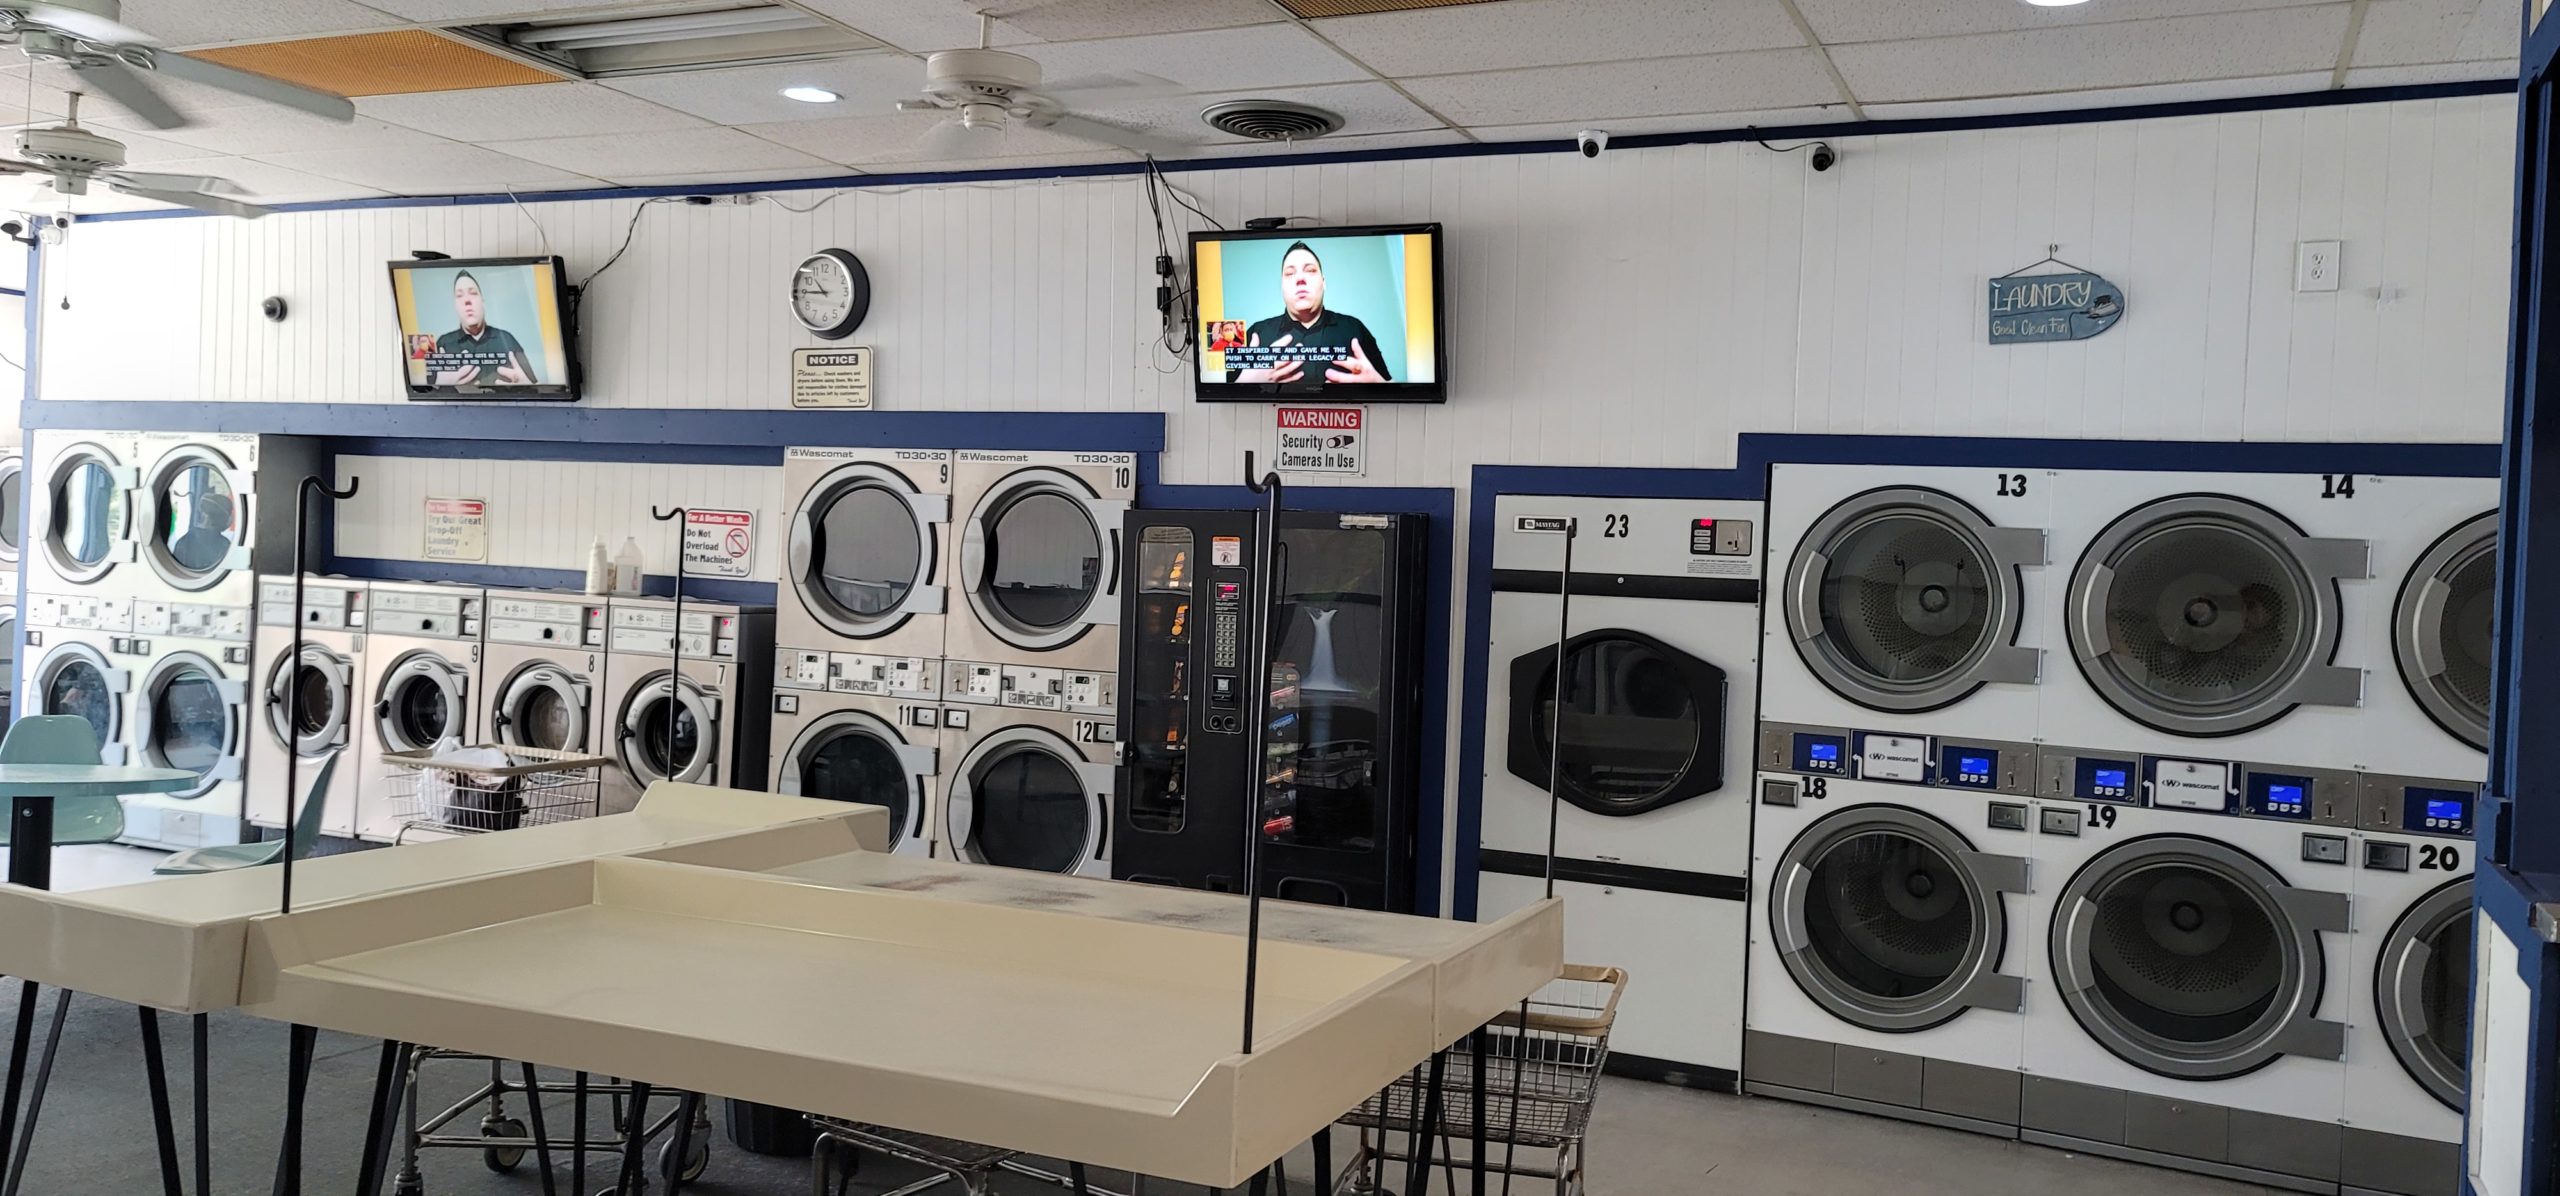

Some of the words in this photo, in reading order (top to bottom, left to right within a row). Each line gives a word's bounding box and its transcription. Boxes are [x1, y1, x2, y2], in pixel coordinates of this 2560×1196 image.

[1991, 281, 2092, 312] LAUNDRY
[1992, 319, 2016, 336] Good
[2021, 319, 2048, 336] Clean
[2048, 317, 2068, 334] Fun
[809, 355, 856, 365] NOTICE
[1282, 411, 1357, 427] WARNING
[1282, 433, 1323, 452] Security
[800, 449, 854, 458] Wascomat
[970, 452, 1029, 462] Wascomat
[1282, 452, 1322, 467] Cameras
[1325, 453, 1334, 467] In
[1337, 453, 1354, 468] Use
[940, 463, 948, 484] 9
[1115, 466, 1130, 489] 10
[1996, 473, 2027, 497] 13
[2321, 474, 2355, 499] 14
[687, 528, 696, 537] Do
[698, 529, 711, 538] Not
[1535, 521, 1560, 529] MAYTAG
[1604, 513, 1629, 538] 23
[686, 541, 719, 551] Overload
[685, 553, 698, 562] The
[700, 554, 733, 565] Machines
[471, 644, 478, 663] 9
[588, 654, 595, 673] 8
[718, 664, 725, 684] 7
[898, 704, 911, 726] 11
[1075, 720, 1093, 743] 12
[1886, 755, 1919, 764] wascomat
[1801, 776, 1827, 800] 18
[2182, 781, 2220, 791] wascomat
[2087, 804, 2117, 829] 19
[2419, 843, 2460, 872] 20
